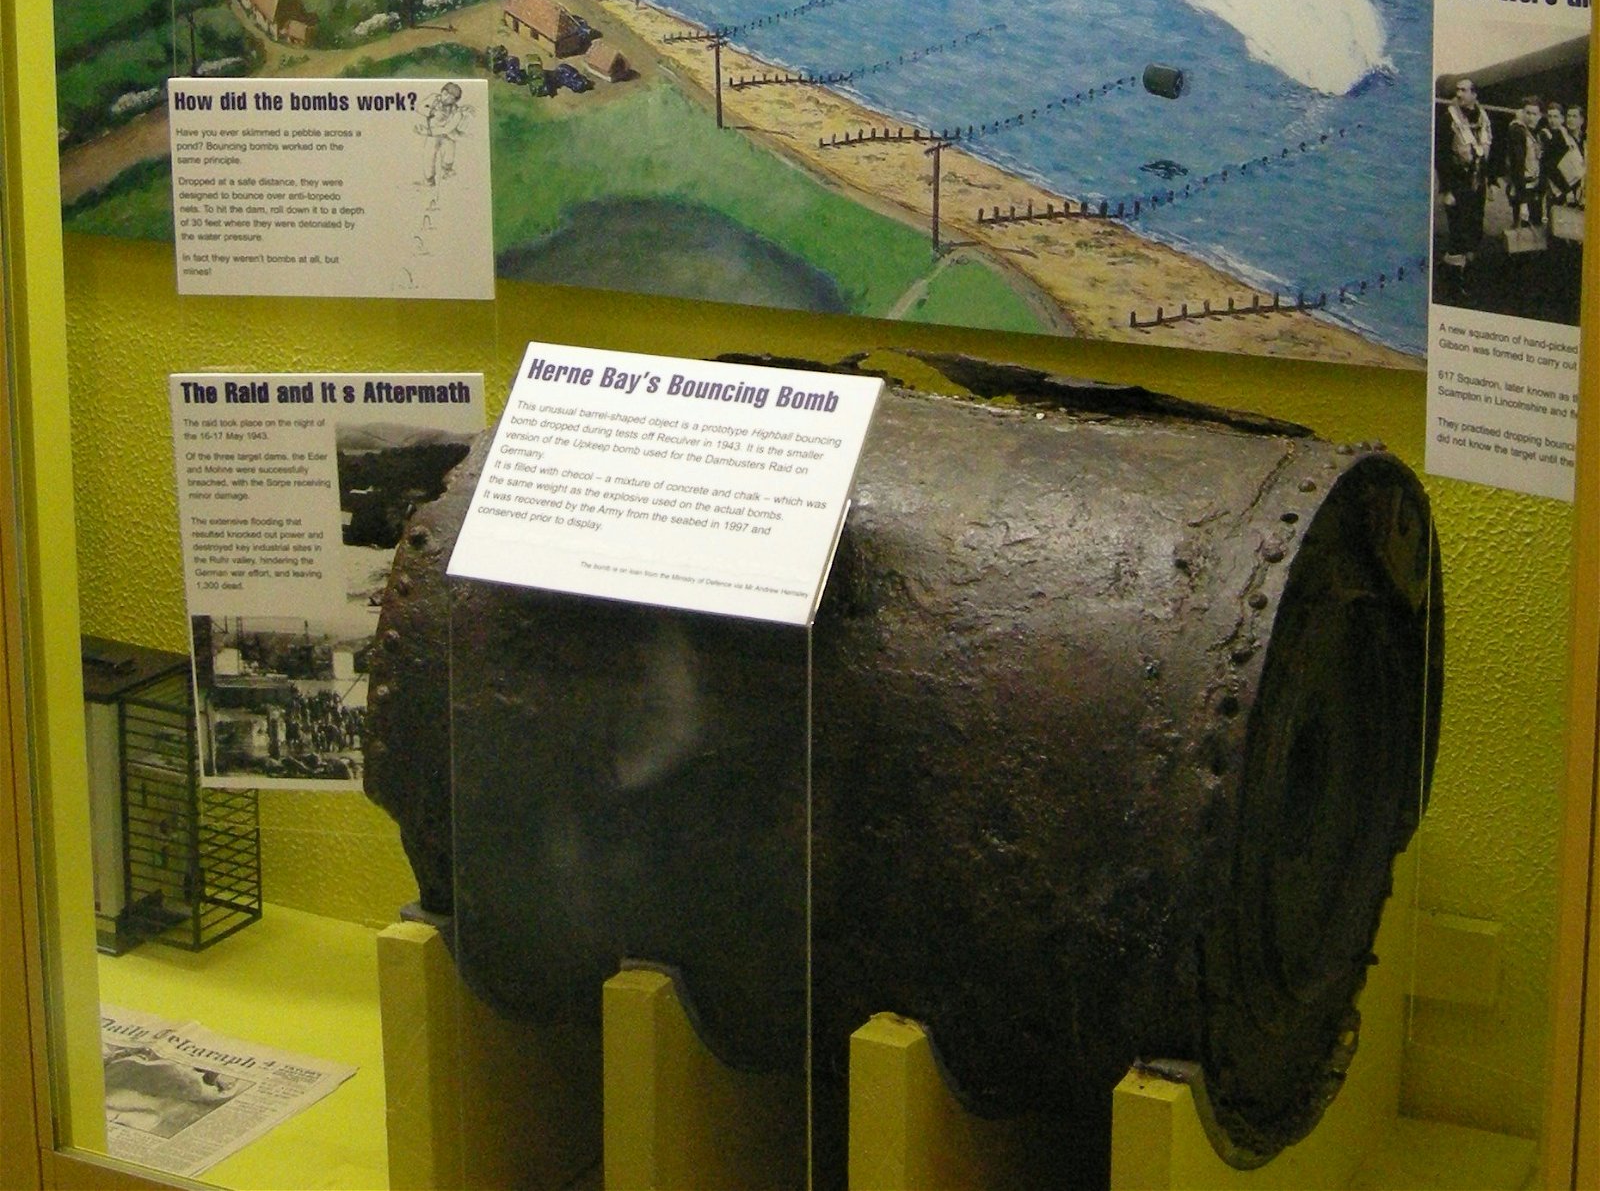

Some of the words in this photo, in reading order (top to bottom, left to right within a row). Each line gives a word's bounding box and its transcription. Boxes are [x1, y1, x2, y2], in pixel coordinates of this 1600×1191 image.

[175, 92, 212, 110] How
[220, 92, 247, 110] did
[255, 92, 282, 110] the
[290, 92, 349, 111] bombs
[357, 92, 416, 111] work?
[177, 142, 203, 151] pond?
[206, 142, 247, 152] Bouncing
[282, 143, 313, 151] worked
[330, 143, 344, 151] the
[1439, 323, 1446, 332] A
[1448, 326, 1466, 335] new
[1469, 330, 1509, 342] squadron
[1512, 335, 1521, 344] of
[1523, 338, 1578, 355] hand-picked
[1439, 338, 1470, 352] Gibson
[1472, 347, 1490, 356] was
[1492, 348, 1523, 361] formed
[1526, 354, 1534, 363] to
[1537, 357, 1559, 369] carry
[1562, 361, 1577, 371] out
[181, 382, 218, 404] The
[225, 382, 269, 403] Raid
[277, 382, 313, 403] and
[364, 382, 470, 403] Aftermath
[528, 359, 593, 385] Herne
[600, 367, 660, 393] Bay's
[667, 375, 769, 408] Bouncing
[776, 386, 839, 412] Bomb
[201, 432, 222, 440] 16-17
[226, 432, 243, 441] May
[247, 432, 268, 440] 1943.
[511, 416, 537, 426] bomb
[540, 420, 580, 432] dropped
[582, 426, 613, 438] during
[615, 429, 638, 439] tests
[642, 432, 655, 440] off
[657, 433, 700, 446] Reculver
[703, 439, 712, 447] in
[747, 444, 754, 452] It
[756, 446, 764, 454] is
[768, 447, 784, 455] the
[787, 450, 823, 460] smaller
[518, 400, 536, 411] This
[539, 406, 577, 415] unusual
[579, 409, 646, 424] barrel-shaped
[648, 418, 679, 428] object
[701, 425, 748, 436] prototype
[752, 429, 794, 440] Highball
[795, 434, 842, 448] bouncing
[500, 444, 543, 460] Germany.
[506, 432, 540, 442] version
[554, 437, 570, 446] the
[573, 439, 610, 452] Upkeep
[612, 444, 640, 455] bomb
[643, 450, 668, 458] used
[670, 450, 683, 459] for
[686, 453, 702, 462] the
[705, 454, 765, 470] Dambusters
[769, 462, 792, 472] Raid
[478, 506, 528, 519] conserved
[529, 514, 552, 522] prior
[555, 516, 564, 524] to
[483, 490, 490, 498] It
[493, 493, 511, 501] was
[514, 496, 563, 508] recovered
[565, 501, 577, 512] by
[580, 504, 595, 512] the
[597, 505, 624, 518] Army
[627, 508, 649, 519] from
[652, 513, 668, 522] the
[671, 516, 708, 527] seabed
[725, 522, 749, 531] 1997
[751, 527, 771, 535] and
[153, 1029, 256, 1068] Telegraph
